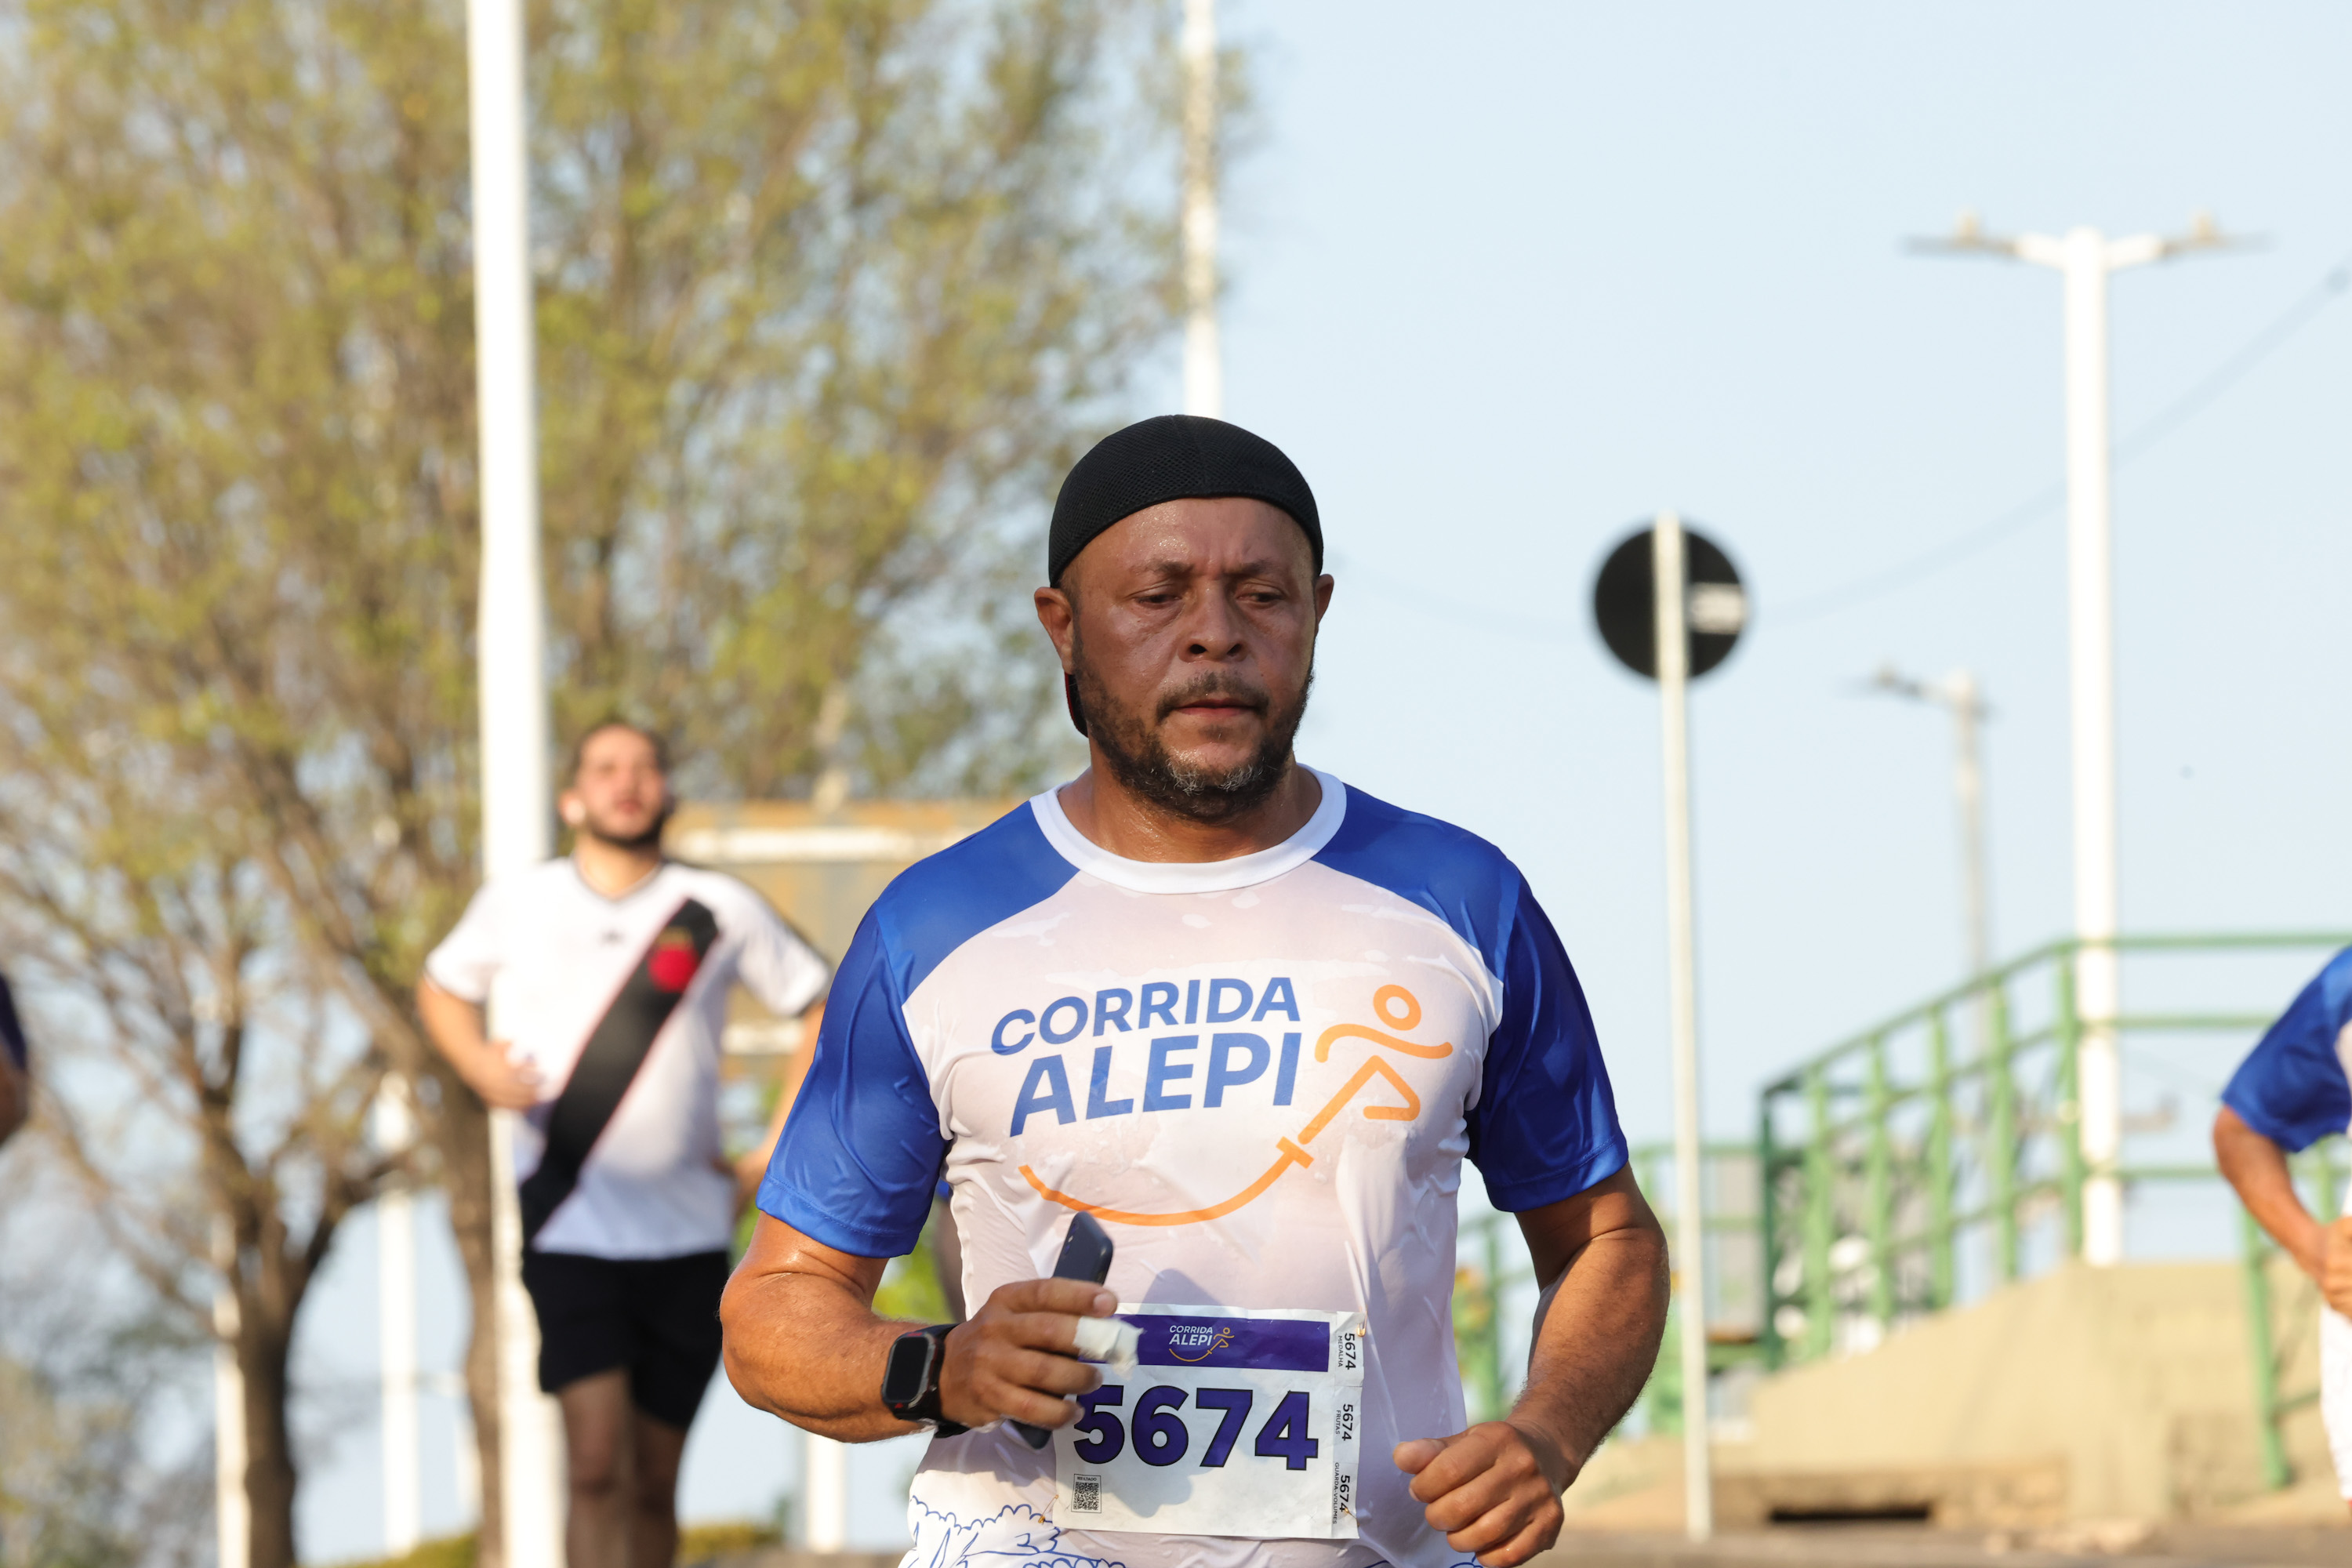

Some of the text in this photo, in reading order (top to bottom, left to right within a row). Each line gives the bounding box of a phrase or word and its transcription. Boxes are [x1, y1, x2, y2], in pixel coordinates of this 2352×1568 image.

[991, 977, 1301, 1055] CORRIDA
[1010, 1032, 1302, 1138] ALEPI
[1168, 1334, 1213, 1346] ALEPI
[1169, 1325, 1213, 1334] CORRIDA
[1345, 1333, 1356, 1370] 5674
[1073, 1385, 1319, 1471] 5674
[1342, 1403, 1353, 1441] 5674
[1340, 1475, 1350, 1512] 5674
